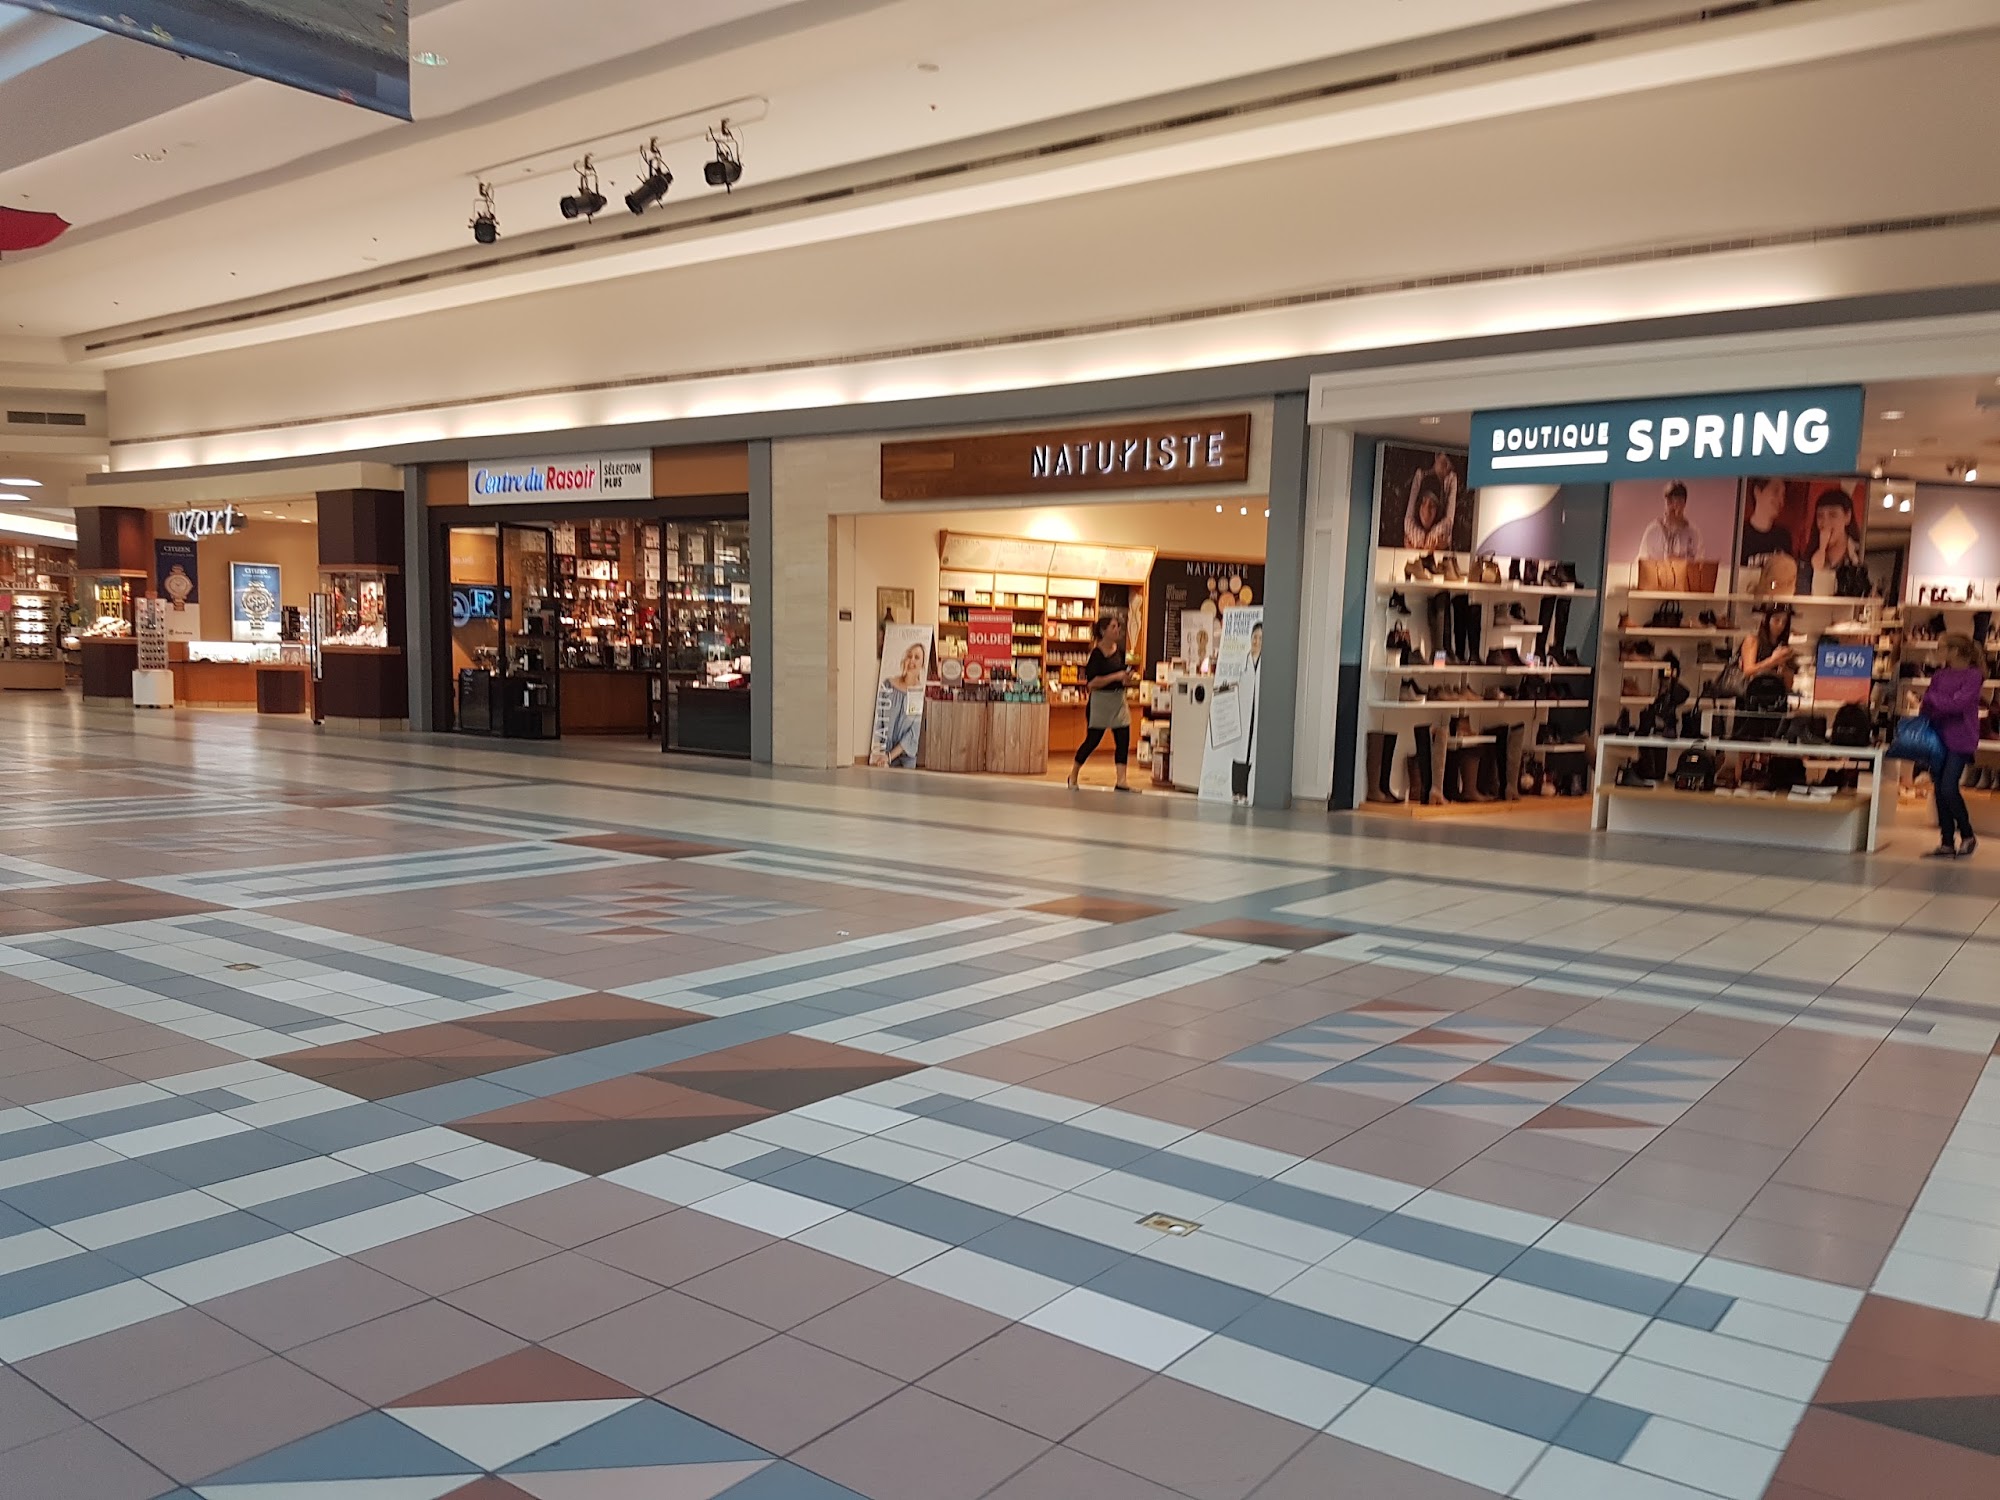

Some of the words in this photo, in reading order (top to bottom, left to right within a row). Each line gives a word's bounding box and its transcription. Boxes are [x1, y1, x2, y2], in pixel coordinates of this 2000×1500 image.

[1492, 422, 1609, 452] BOUTIQUE
[1626, 407, 1829, 463] SPRING
[603, 461, 642, 476] SÉLECTION
[474, 467, 524, 495] Centre
[524, 465, 545, 492] du
[546, 463, 596, 490] Rasoir
[603, 476, 622, 489] PLUS
[163, 545, 191, 553] CITIZEN
[244, 567, 268, 575] CITIZEN
[969, 632, 1011, 645] SOLDES
[1824, 652, 1865, 669] 50%
